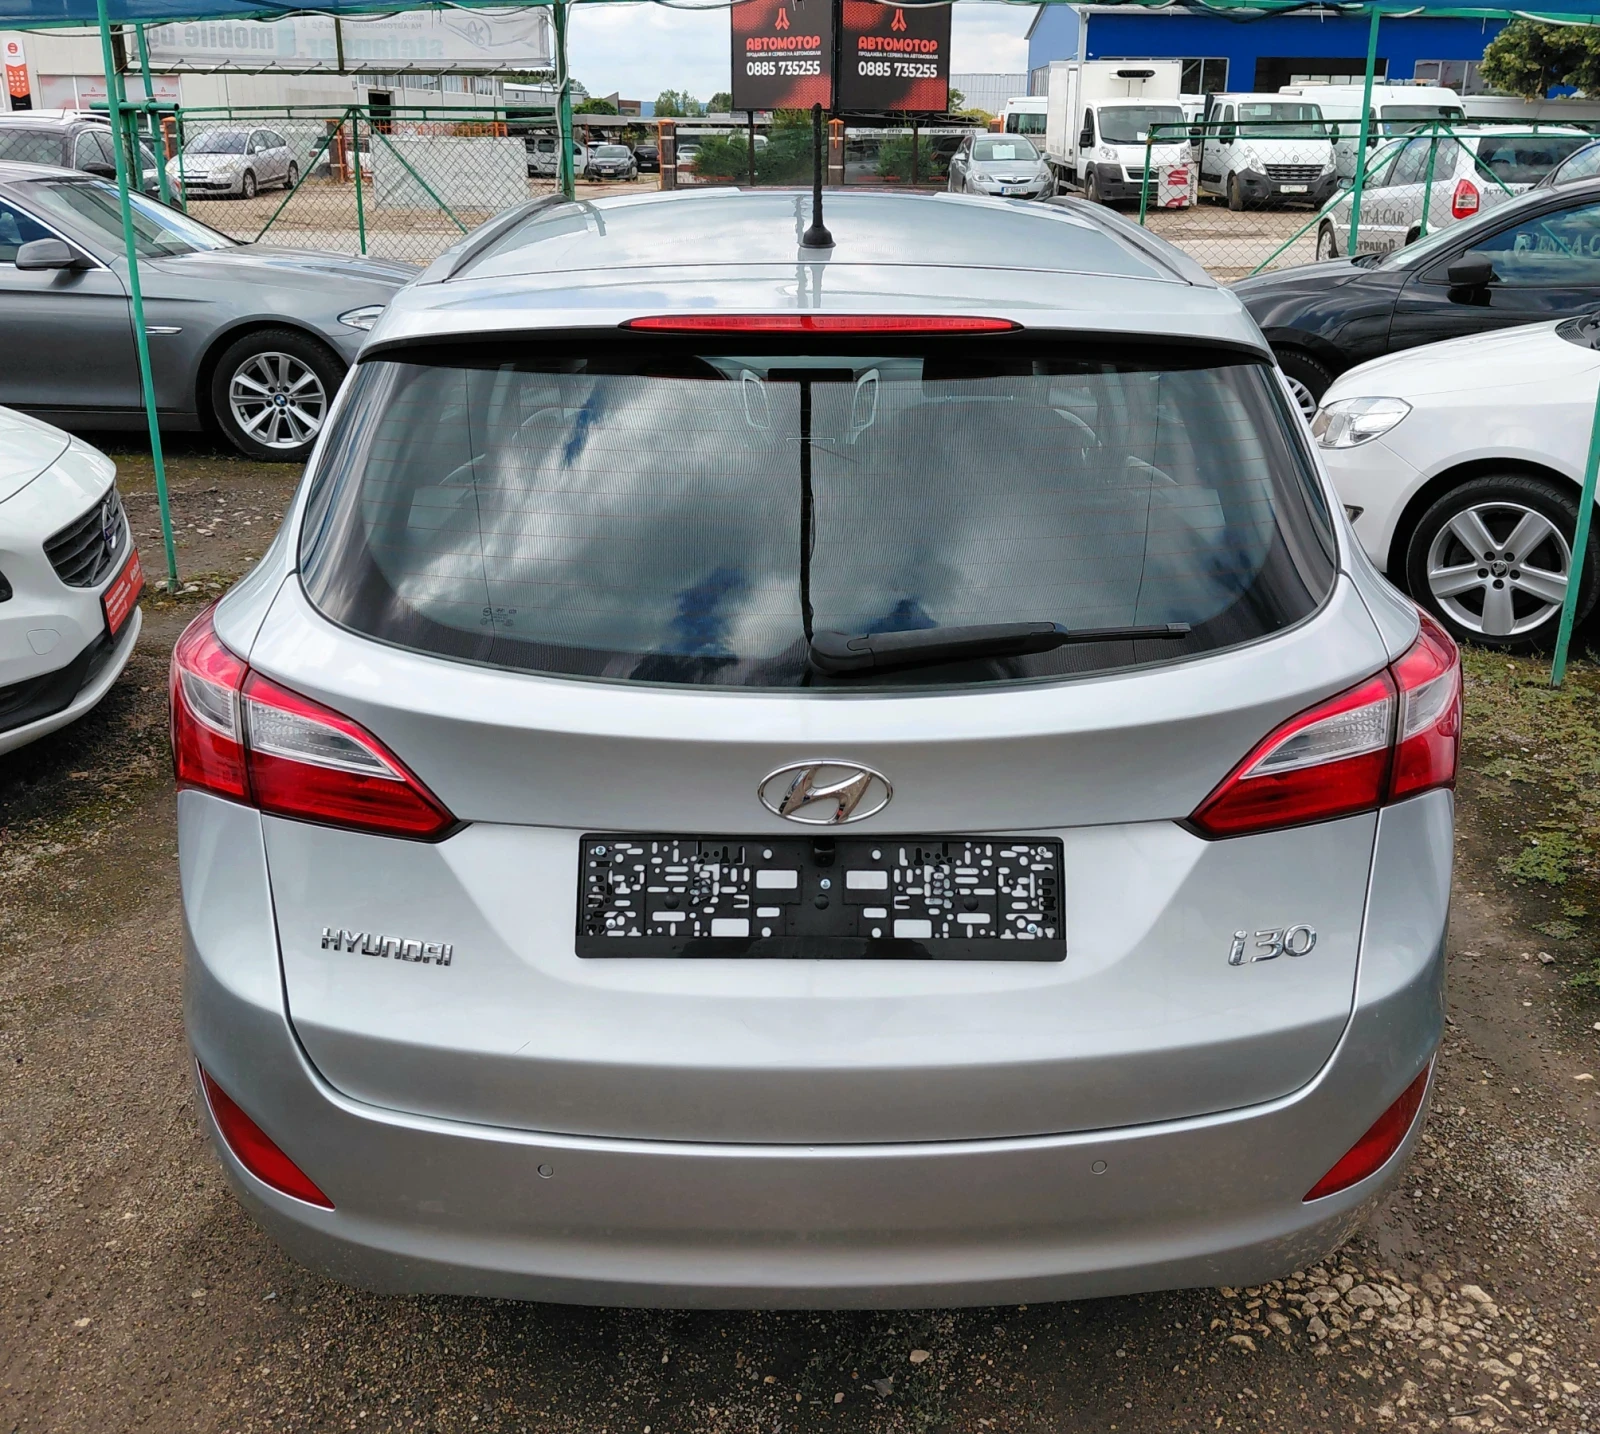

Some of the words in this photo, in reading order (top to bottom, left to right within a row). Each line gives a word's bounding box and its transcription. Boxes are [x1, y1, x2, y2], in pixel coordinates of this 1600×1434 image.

[746, 35, 821, 51] АВТОМОТОР
[858, 36, 938, 53] АВТОМОТОР
[746, 61, 776, 76] 0885
[778, 60, 821, 75] 735255
[858, 61, 891, 77] 0885
[894, 62, 938, 78] 735255
[1346, 208, 1405, 225] RNT-A-CAR
[321, 926, 453, 966] HYUNDAI
[1228, 922, 1317, 967] i30
